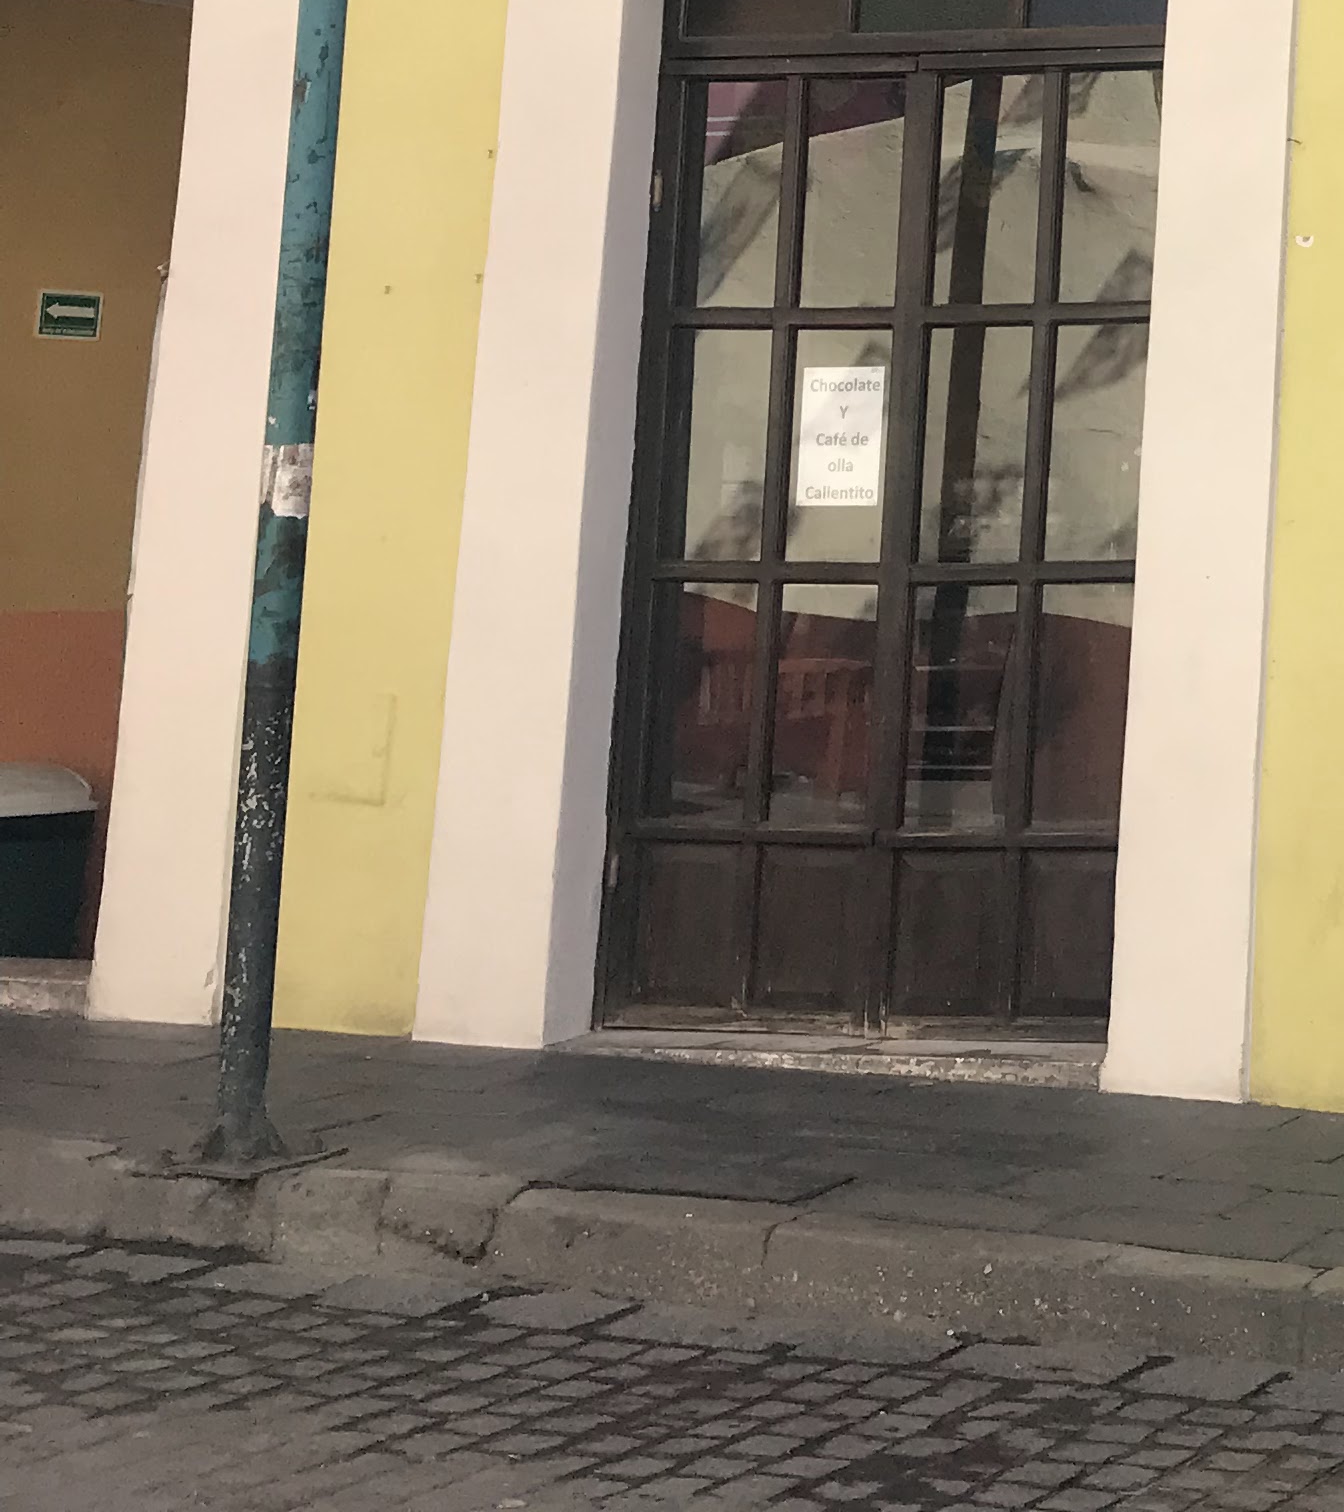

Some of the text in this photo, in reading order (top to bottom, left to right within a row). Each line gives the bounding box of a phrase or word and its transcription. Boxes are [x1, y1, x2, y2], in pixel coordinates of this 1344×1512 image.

[810, 378, 881, 393] Chocolate
[839, 405, 849, 420] Y
[816, 432, 869, 447] Café de
[827, 458, 854, 473] olla
